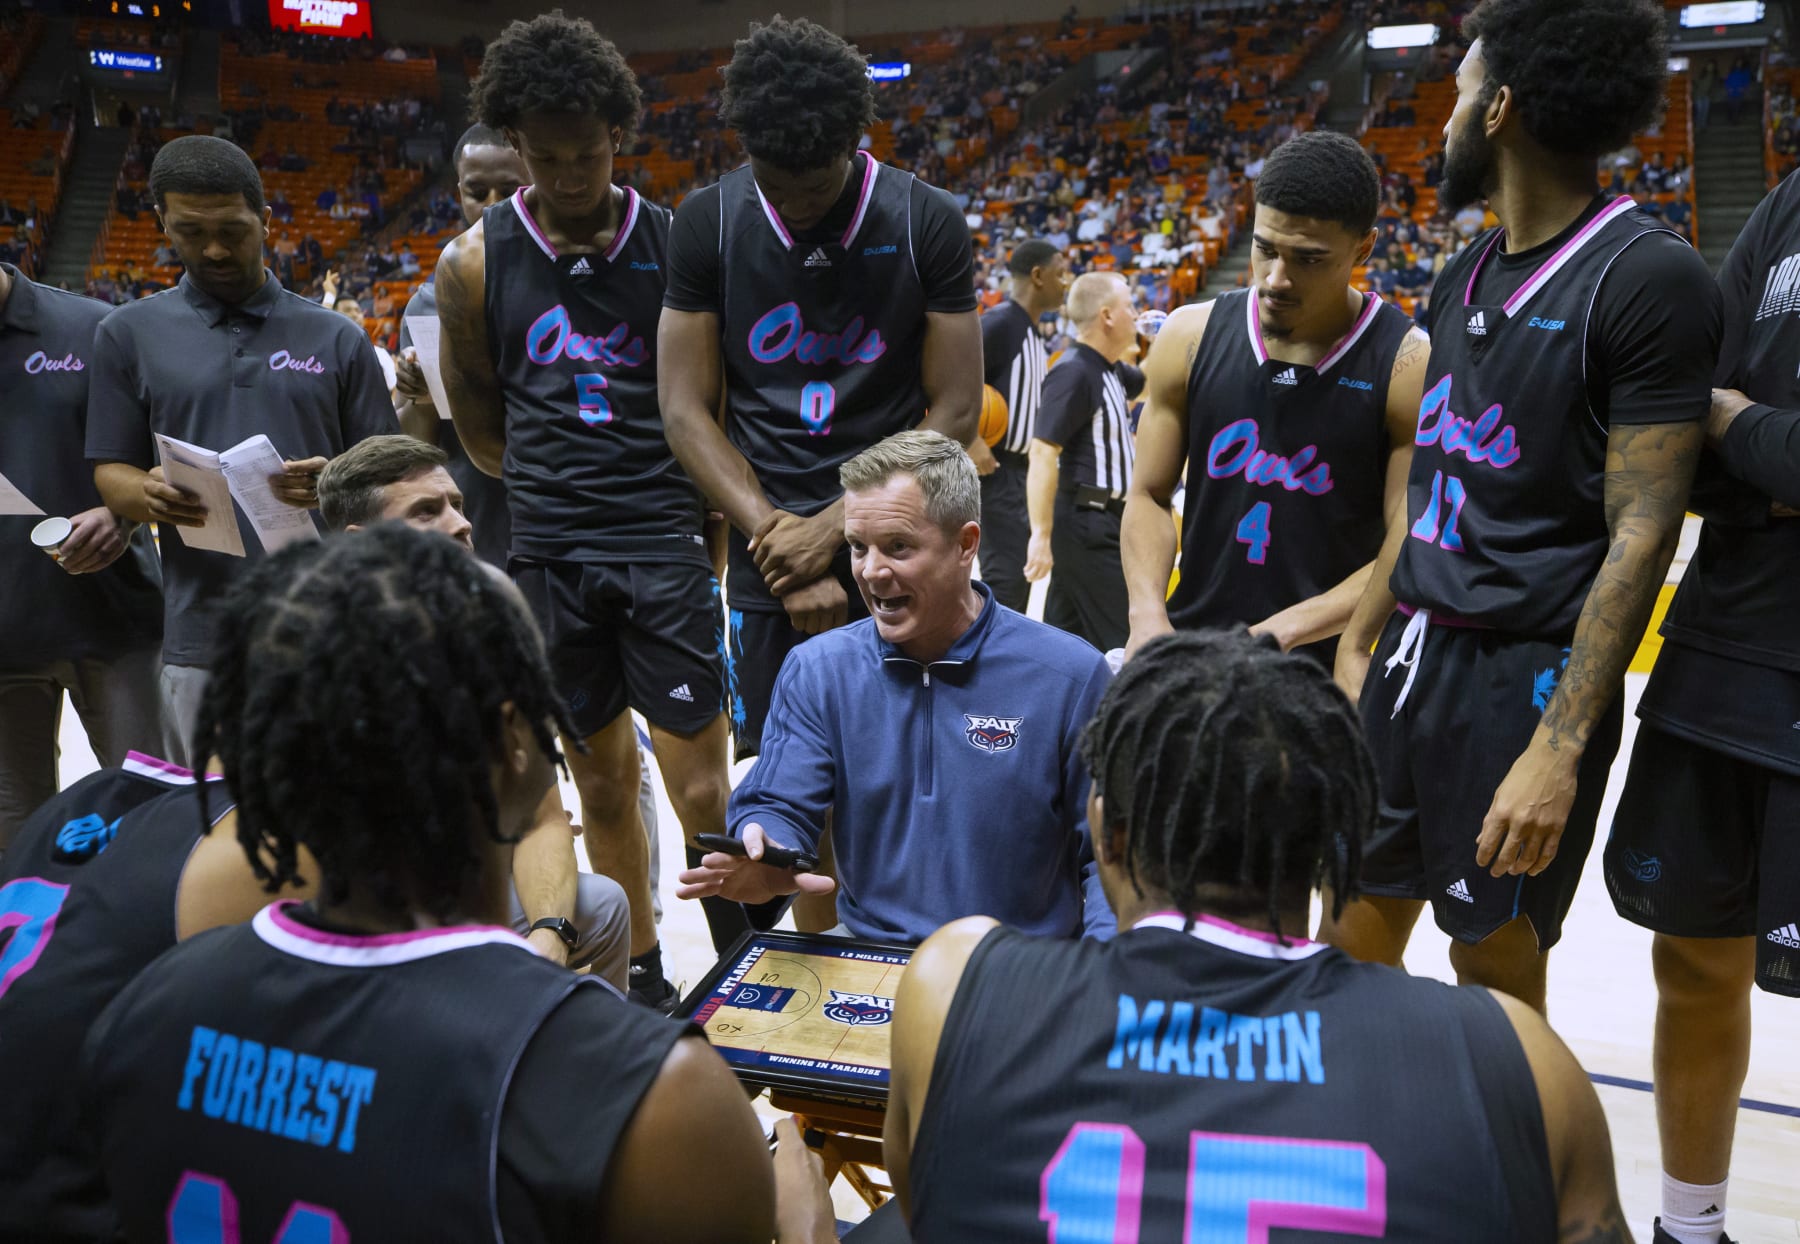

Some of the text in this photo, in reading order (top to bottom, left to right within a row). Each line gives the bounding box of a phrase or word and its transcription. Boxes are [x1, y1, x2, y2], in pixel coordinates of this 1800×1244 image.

[569, 267, 595, 276] adidas
[804, 257, 833, 267] adidas
[526, 304, 650, 368] Owls
[748, 301, 888, 365] Owls
[24, 350, 85, 375] Owls
[268, 349, 326, 374] Owls
[1271, 375, 1298, 386] adidas
[574, 373, 614, 428] 5
[800, 379, 836, 436] 0
[1415, 373, 1521, 469] Owls
[1207, 418, 1335, 496] Owls
[1235, 500, 1272, 566] 4
[669, 691, 694, 702] adidas
[966, 716, 1021, 735] FAU
[1446, 888, 1474, 903] adidas
[1766, 931, 1800, 949] adida
[716, 945, 766, 995] ATLANTIC
[855, 953, 885, 962] MILES
[826, 989, 895, 1012] FAU
[1106, 992, 1326, 1085] MARTIN
[768, 1055, 882, 1077] WINNING IN PARADISE
[177, 1024, 378, 1154] FORREST
